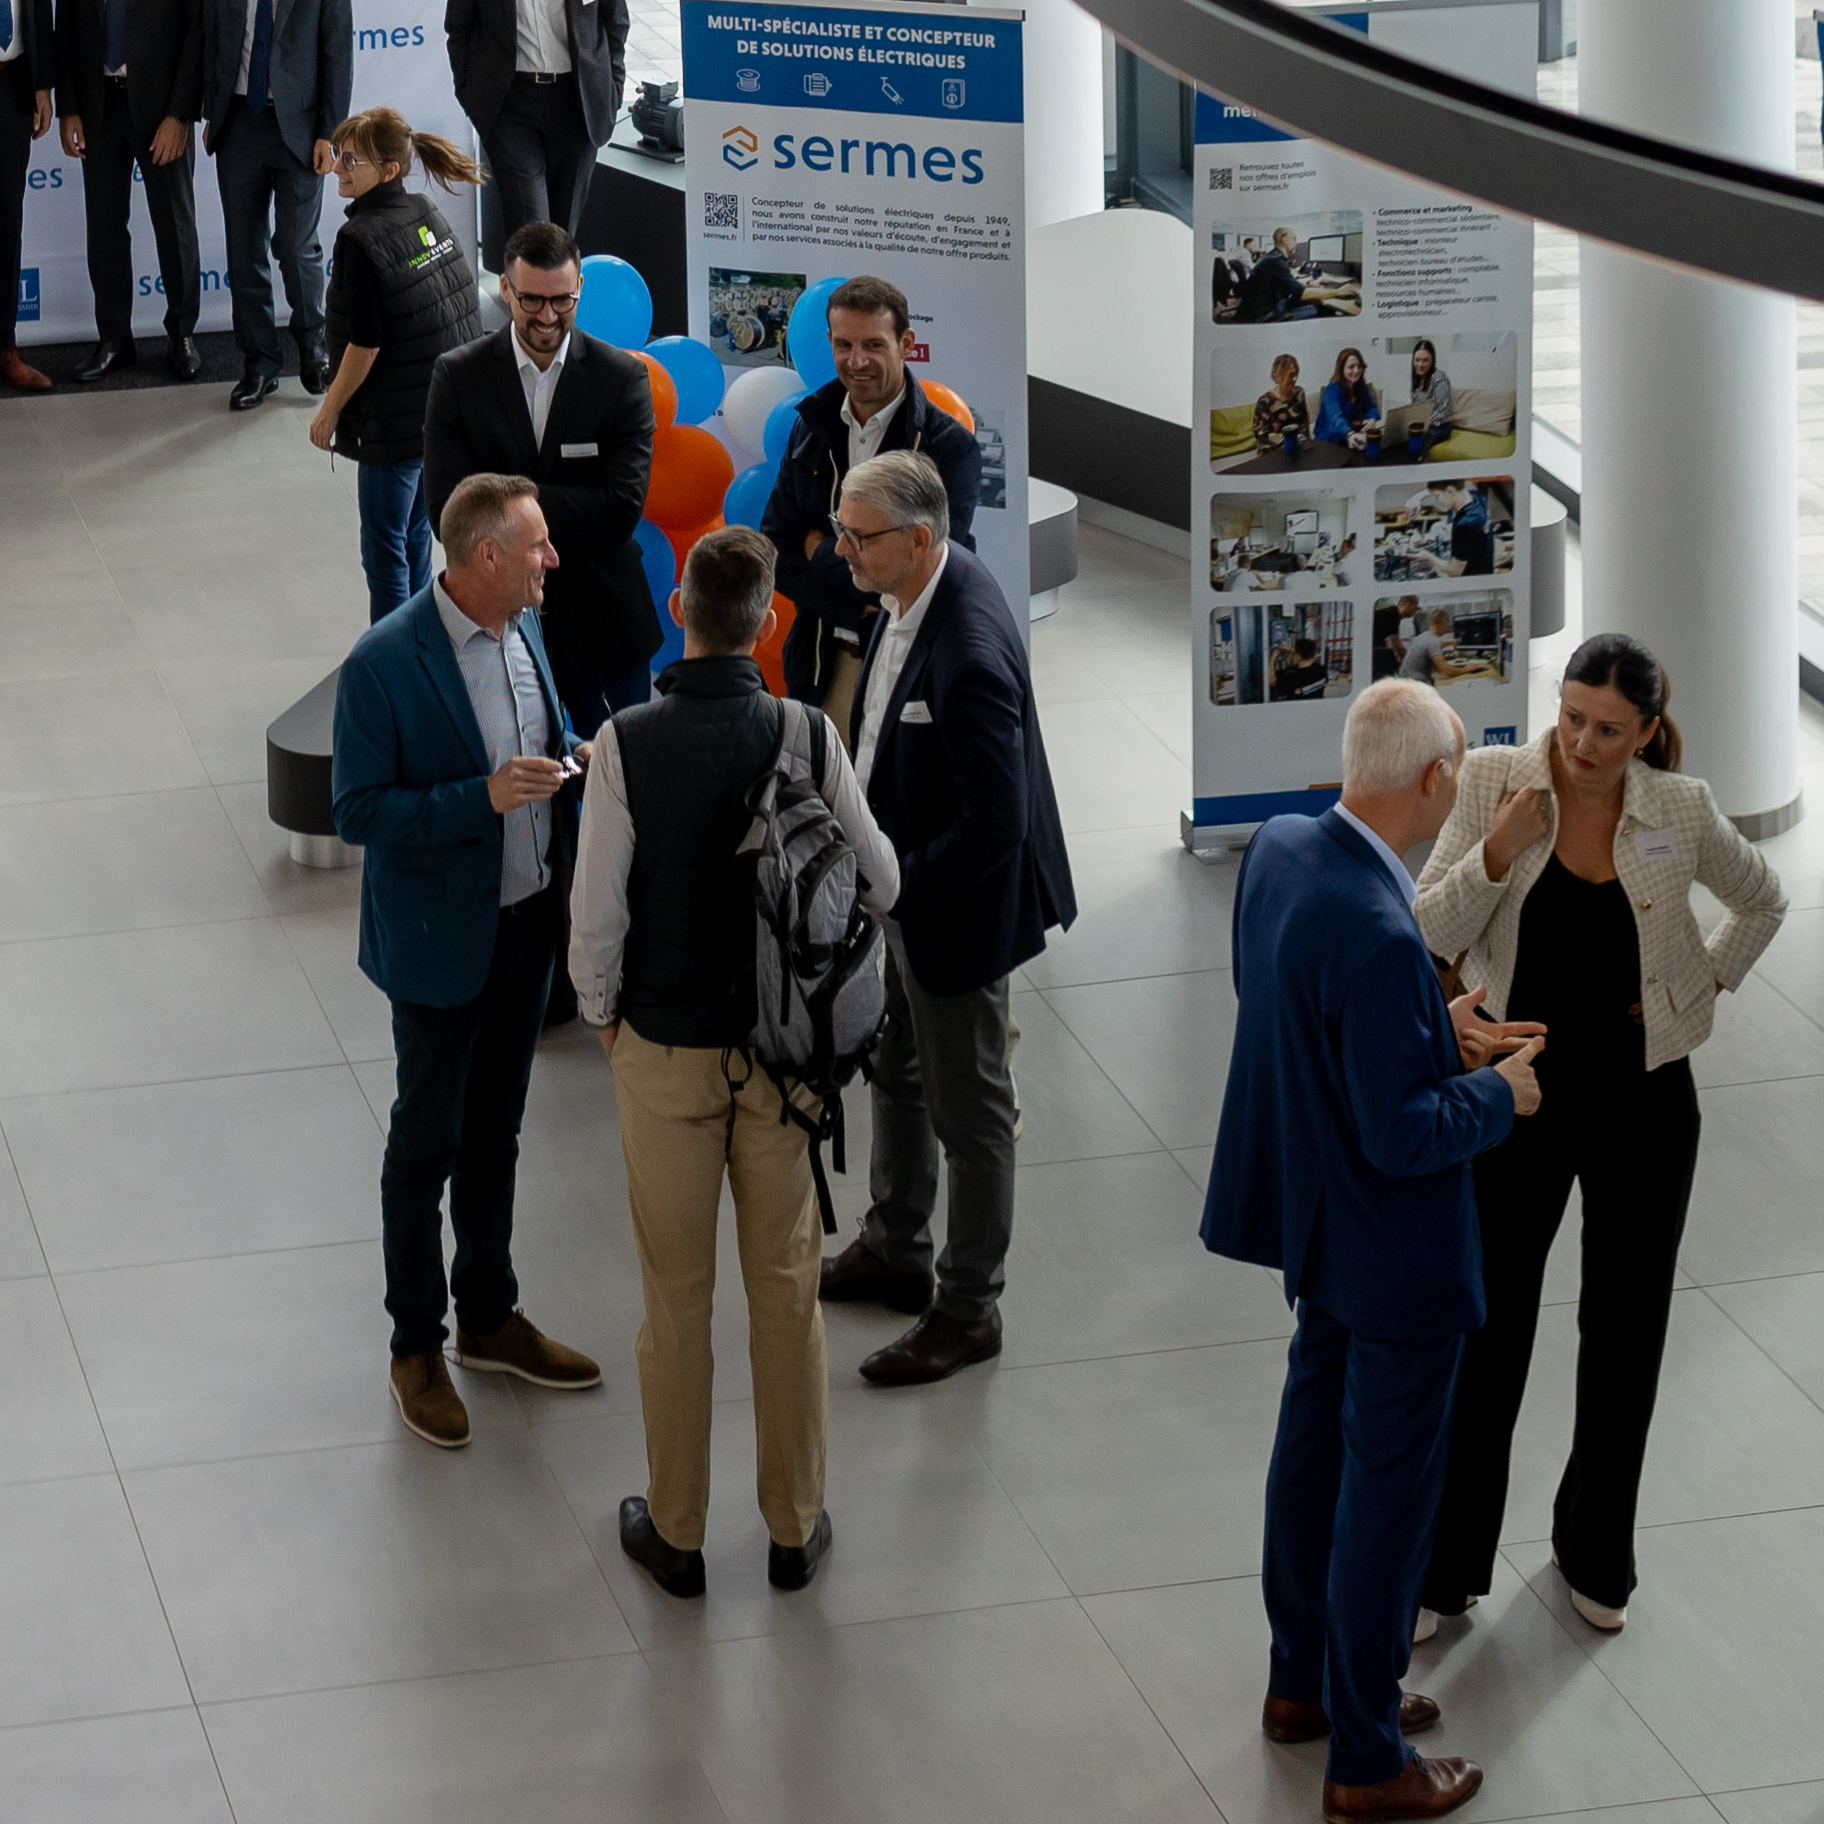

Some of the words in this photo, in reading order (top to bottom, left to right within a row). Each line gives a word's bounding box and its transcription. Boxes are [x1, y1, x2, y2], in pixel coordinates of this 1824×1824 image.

[707, 14, 861, 39] MULTI-SPÉCIALISTE
[865, 26, 883, 40] ET
[886, 27, 996, 49] CONCEPTEUR
[737, 40, 758, 54] DE
[761, 41, 854, 61] SOLUTIONS
[858, 46, 966, 70] ÉLECTRIQUES
[773, 134, 984, 185] sermes
[751, 197, 804, 209] Concepteur
[814, 201, 826, 210] de
[835, 204, 875, 214] solutions
[884, 207, 934, 220] électriques
[944, 214, 975, 224] depuis
[985, 216, 1011, 227] 1949,
[752, 210, 773, 218] nous
[779, 212, 805, 220] avons
[811, 213, 849, 224] construit
[854, 218, 878, 227] notre
[884, 220, 931, 231] réputation
[954, 225, 984, 236] France
[990, 229, 1000, 237] et
[1005, 229, 1011, 238] à
[703, 232, 737, 242] sermes.fr
[752, 220, 813, 232] l'international
[816, 226, 830, 235] par
[833, 228, 849, 236] nos
[851, 229, 883, 240] valeurs
[931, 236, 999, 250] d'engagement
[1001, 241, 1011, 249] et
[752, 233, 767, 242] par
[768, 234, 785, 242] nos
[786, 236, 821, 245] services
[823, 238, 857, 249] associés
[865, 241, 873, 250] la
[875, 243, 905, 253] qualité
[907, 245, 919, 254] de
[920, 247, 944, 256] notre
[945, 248, 968, 258] offre
[969, 251, 1011, 262] produits.
